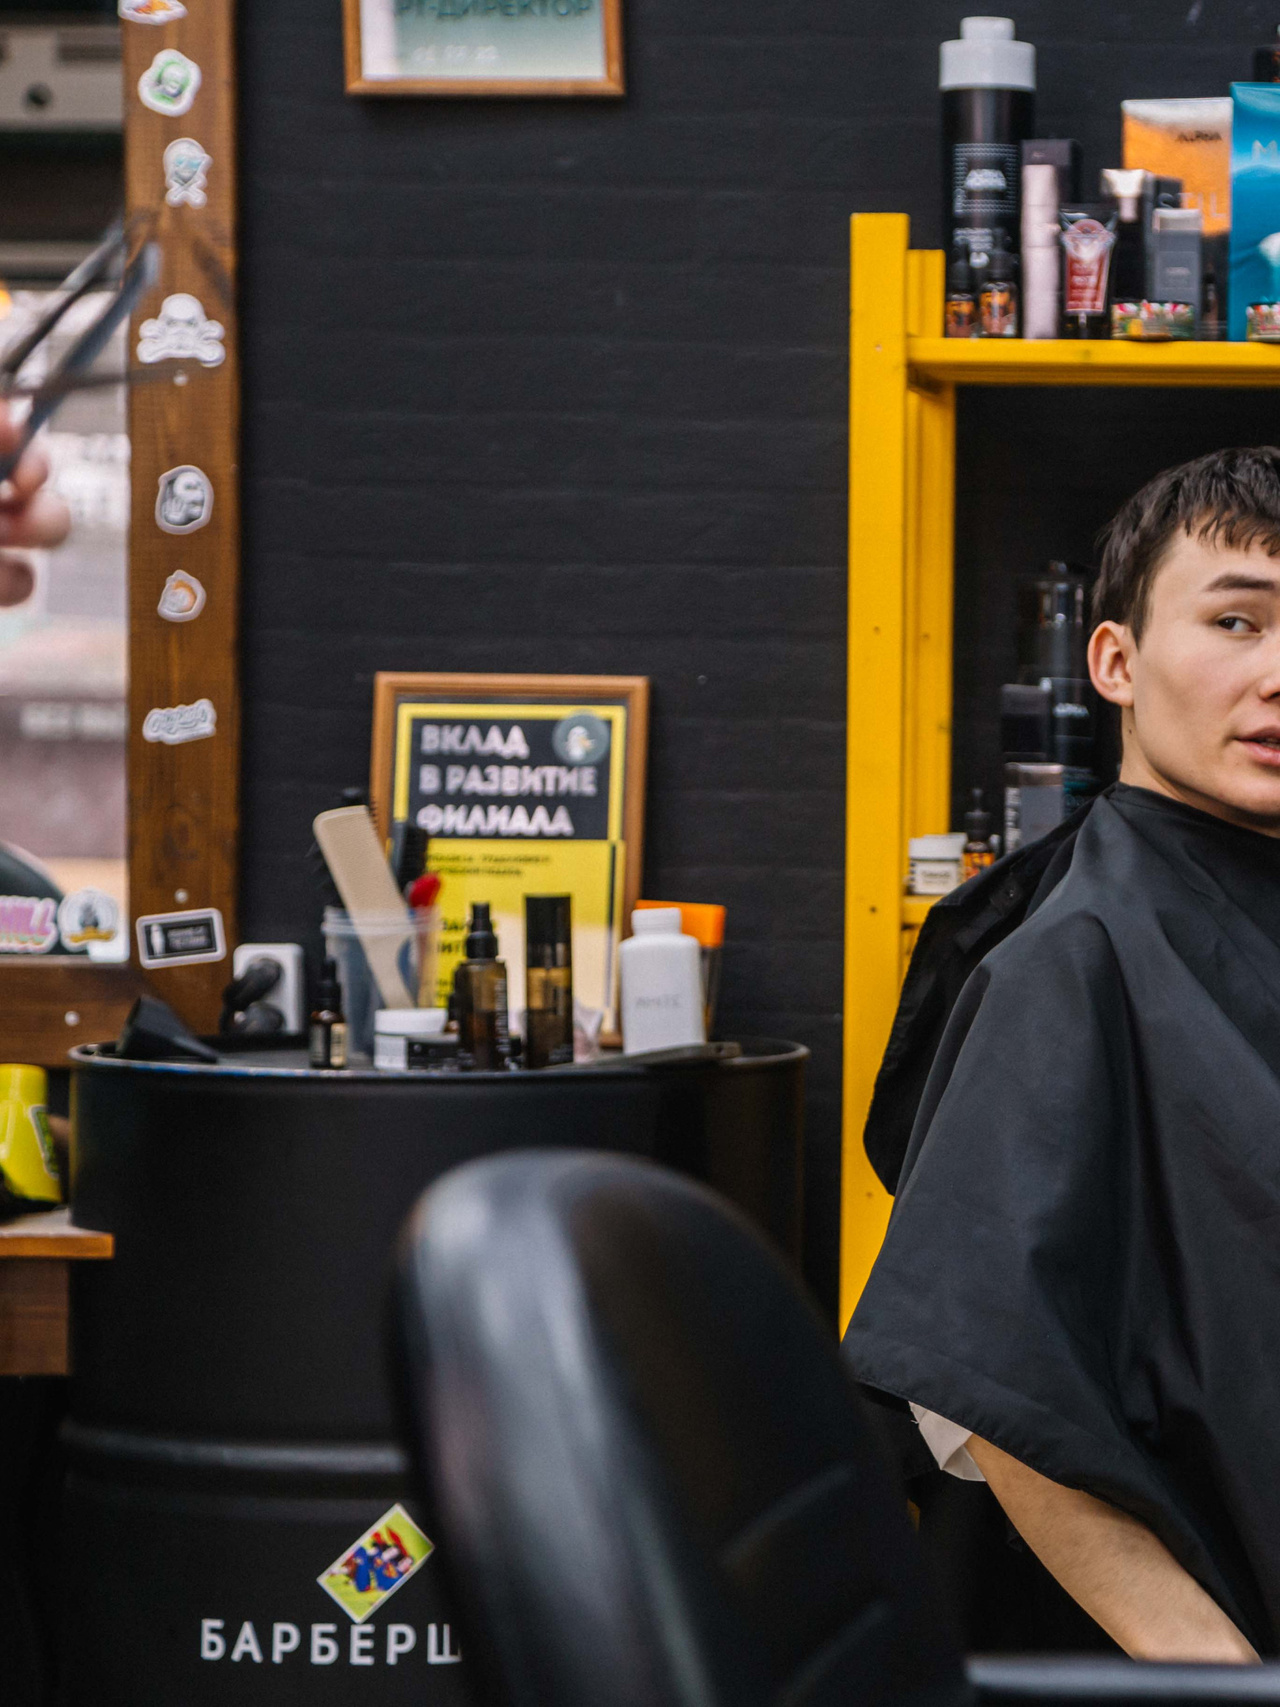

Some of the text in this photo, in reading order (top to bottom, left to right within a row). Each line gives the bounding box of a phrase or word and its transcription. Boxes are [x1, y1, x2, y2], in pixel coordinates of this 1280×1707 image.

[420, 724, 530, 760] ВКЛАД
[419, 766, 598, 796] В РАЗВИТИЕ
[416, 804, 575, 837] ФИЛИАЛА
[200, 1618, 463, 1666] БАРБЕРШ
